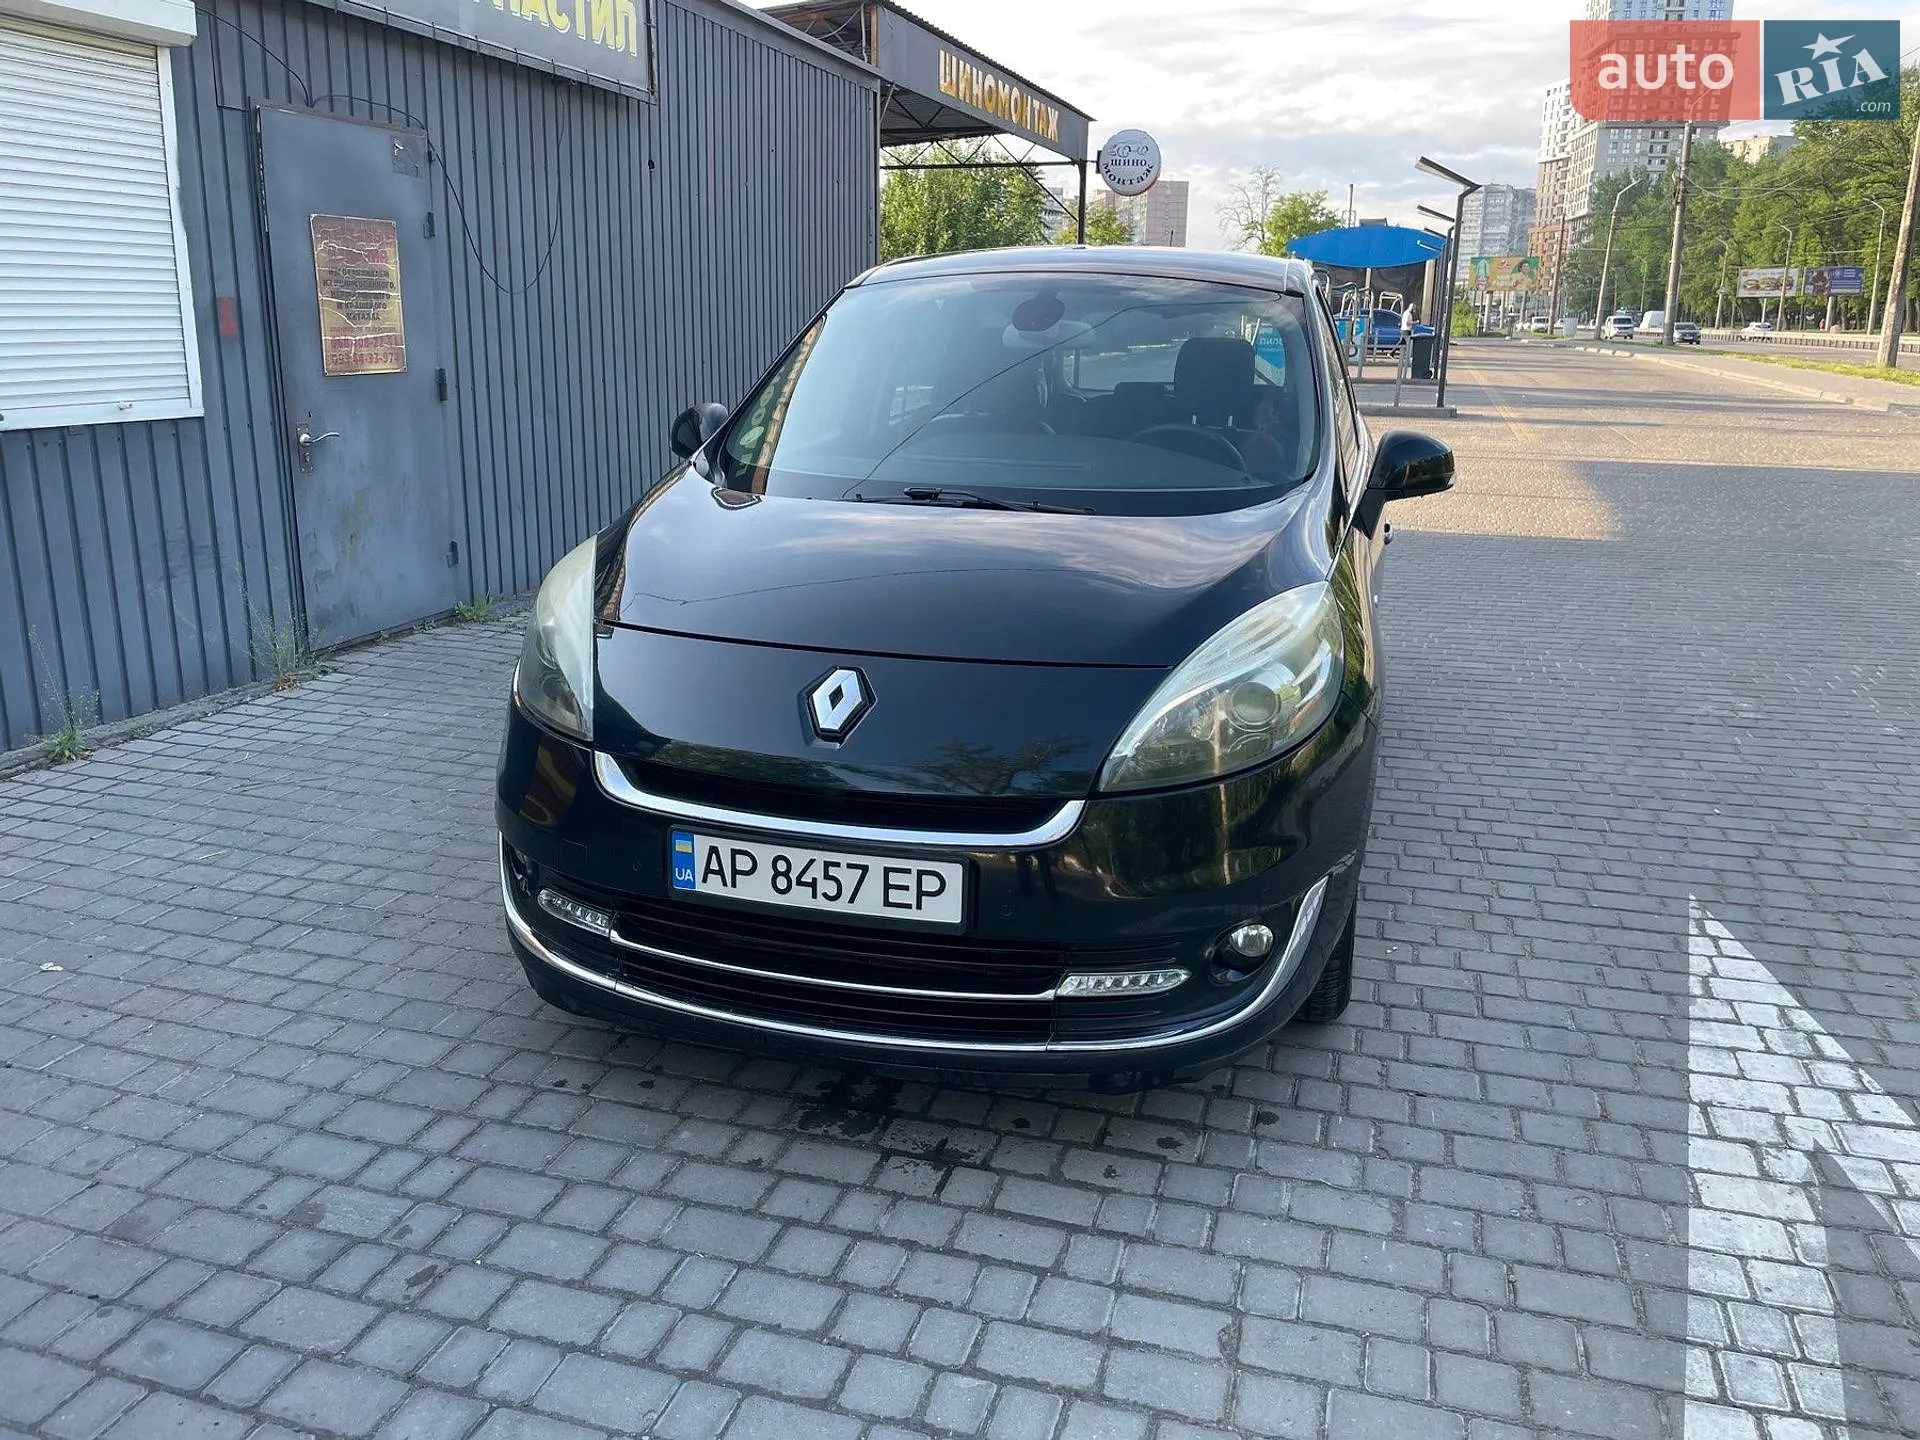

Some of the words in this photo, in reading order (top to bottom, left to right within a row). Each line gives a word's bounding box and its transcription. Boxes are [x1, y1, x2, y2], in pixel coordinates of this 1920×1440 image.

[493, 0, 637, 57] АСТИЛ
[938, 49, 1059, 143] ШИНОМОНТАЖ
[675, 867, 694, 882] UA
[701, 845, 758, 888] AP
[770, 854, 870, 904] 8457
[882, 866, 947, 911] EP
